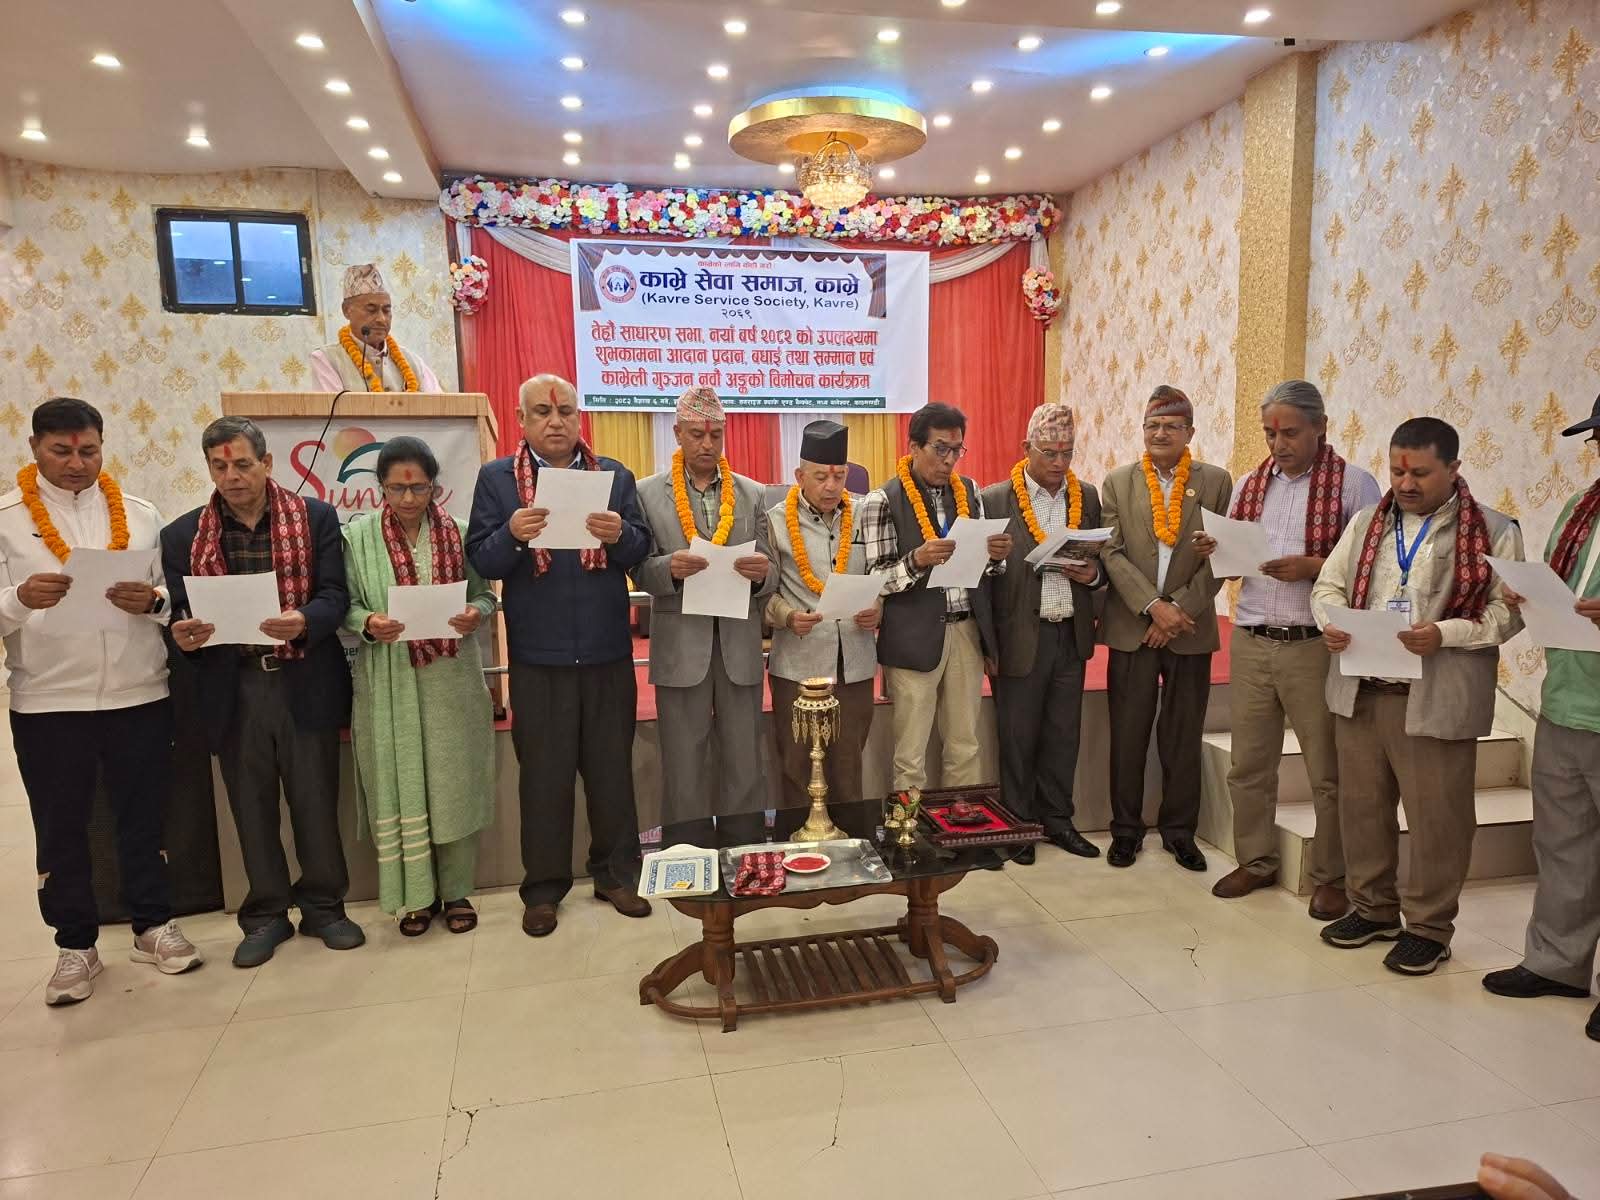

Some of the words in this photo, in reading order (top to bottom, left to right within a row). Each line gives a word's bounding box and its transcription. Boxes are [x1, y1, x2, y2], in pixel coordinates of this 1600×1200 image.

[639, 267, 688, 291] काभ्रे
[694, 268, 734, 291] सेवा
[815, 273, 861, 296] काभ्रे
[641, 292, 690, 305] (Kavre
[694, 294, 749, 306] Service
[753, 295, 809, 310] Society,
[814, 297, 859, 311] Kavre)
[620, 325, 671, 343] साधारण
[796, 326, 813, 345] को
[595, 346, 663, 366] शुभकामना
[667, 348, 708, 364] आदान
[786, 350, 809, 365] तथा
[814, 350, 856, 366] सम्मान
[860, 349, 876, 366] एवं
[652, 372, 694, 391] गुञ्जन
[769, 368, 815, 389] विमोचन
[819, 370, 871, 389] कार्यक्रम
